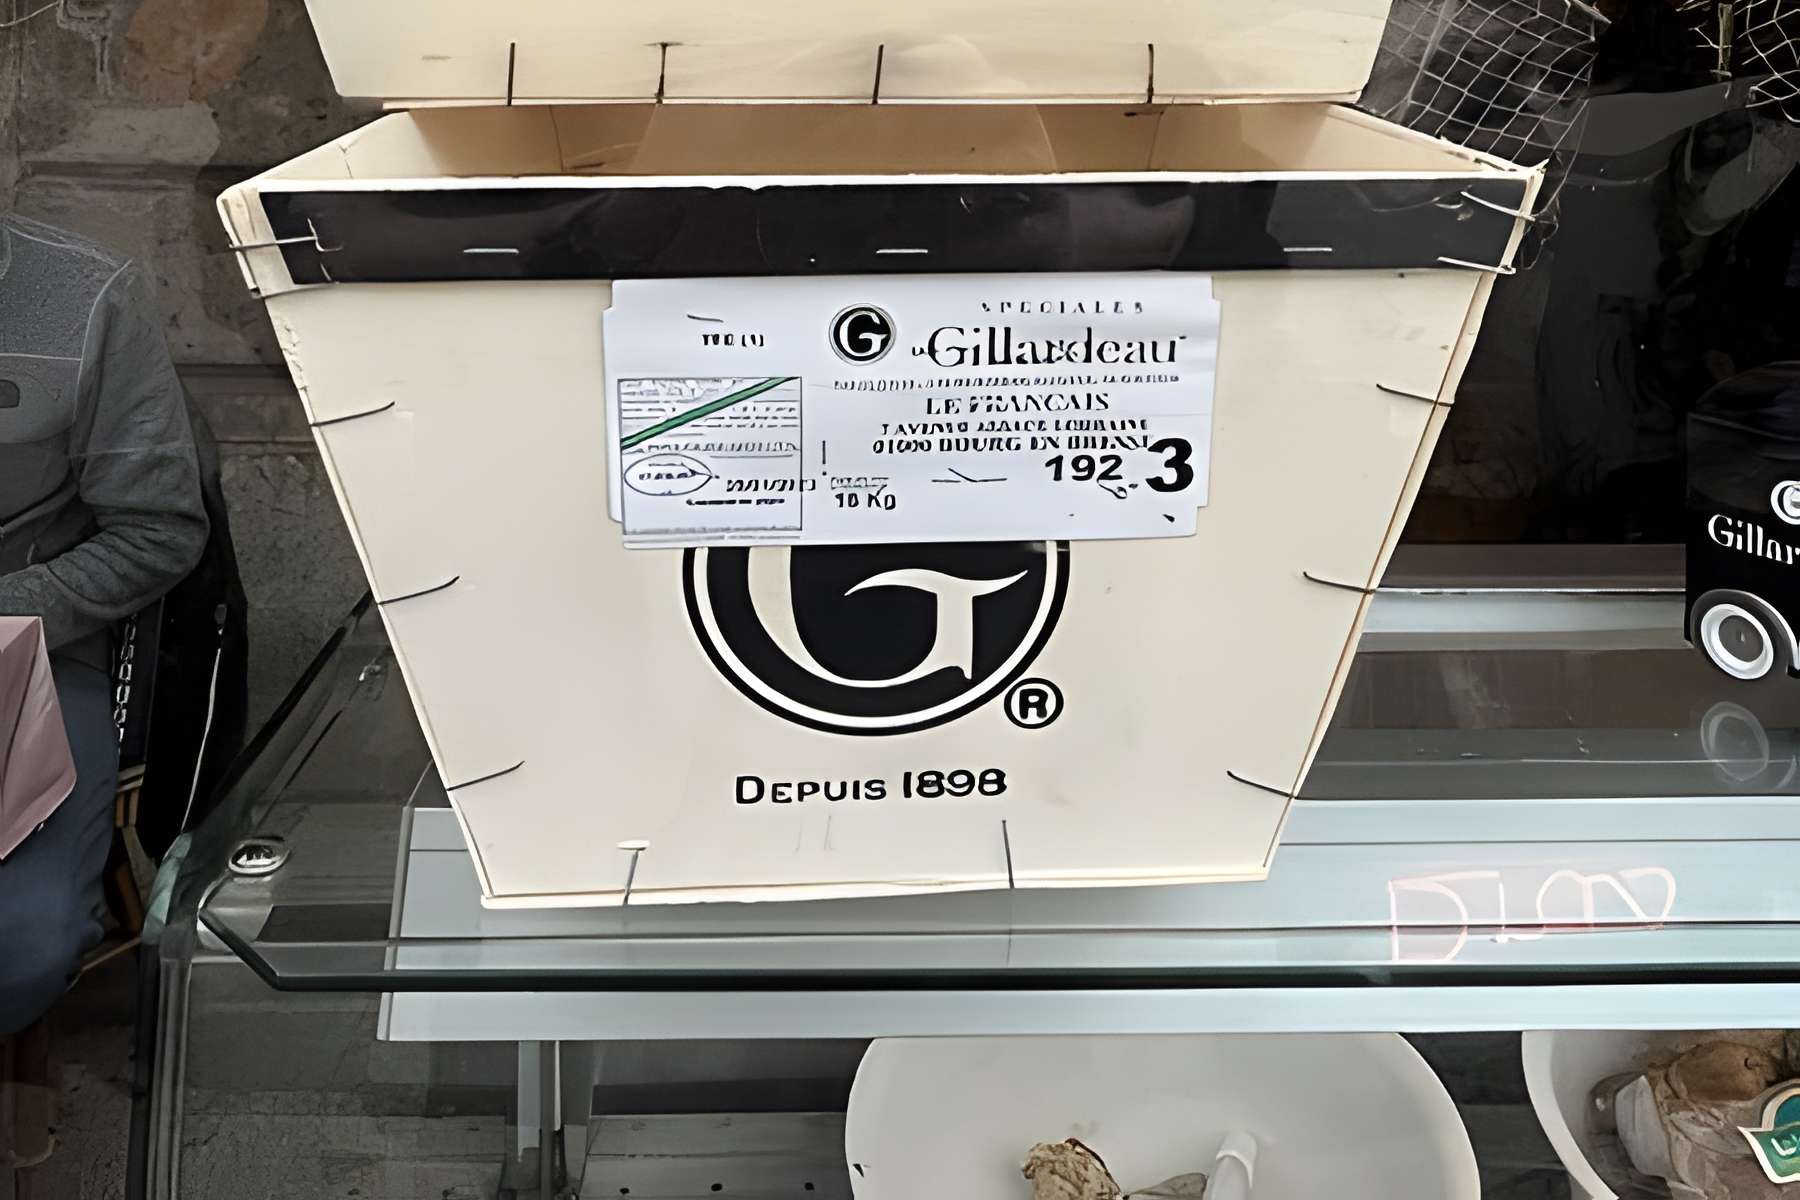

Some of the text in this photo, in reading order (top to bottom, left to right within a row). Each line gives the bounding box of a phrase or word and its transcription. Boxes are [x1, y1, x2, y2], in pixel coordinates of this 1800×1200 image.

[1045, 438, 1195, 492] 192 3
[903, 768, 1008, 798] 1898
